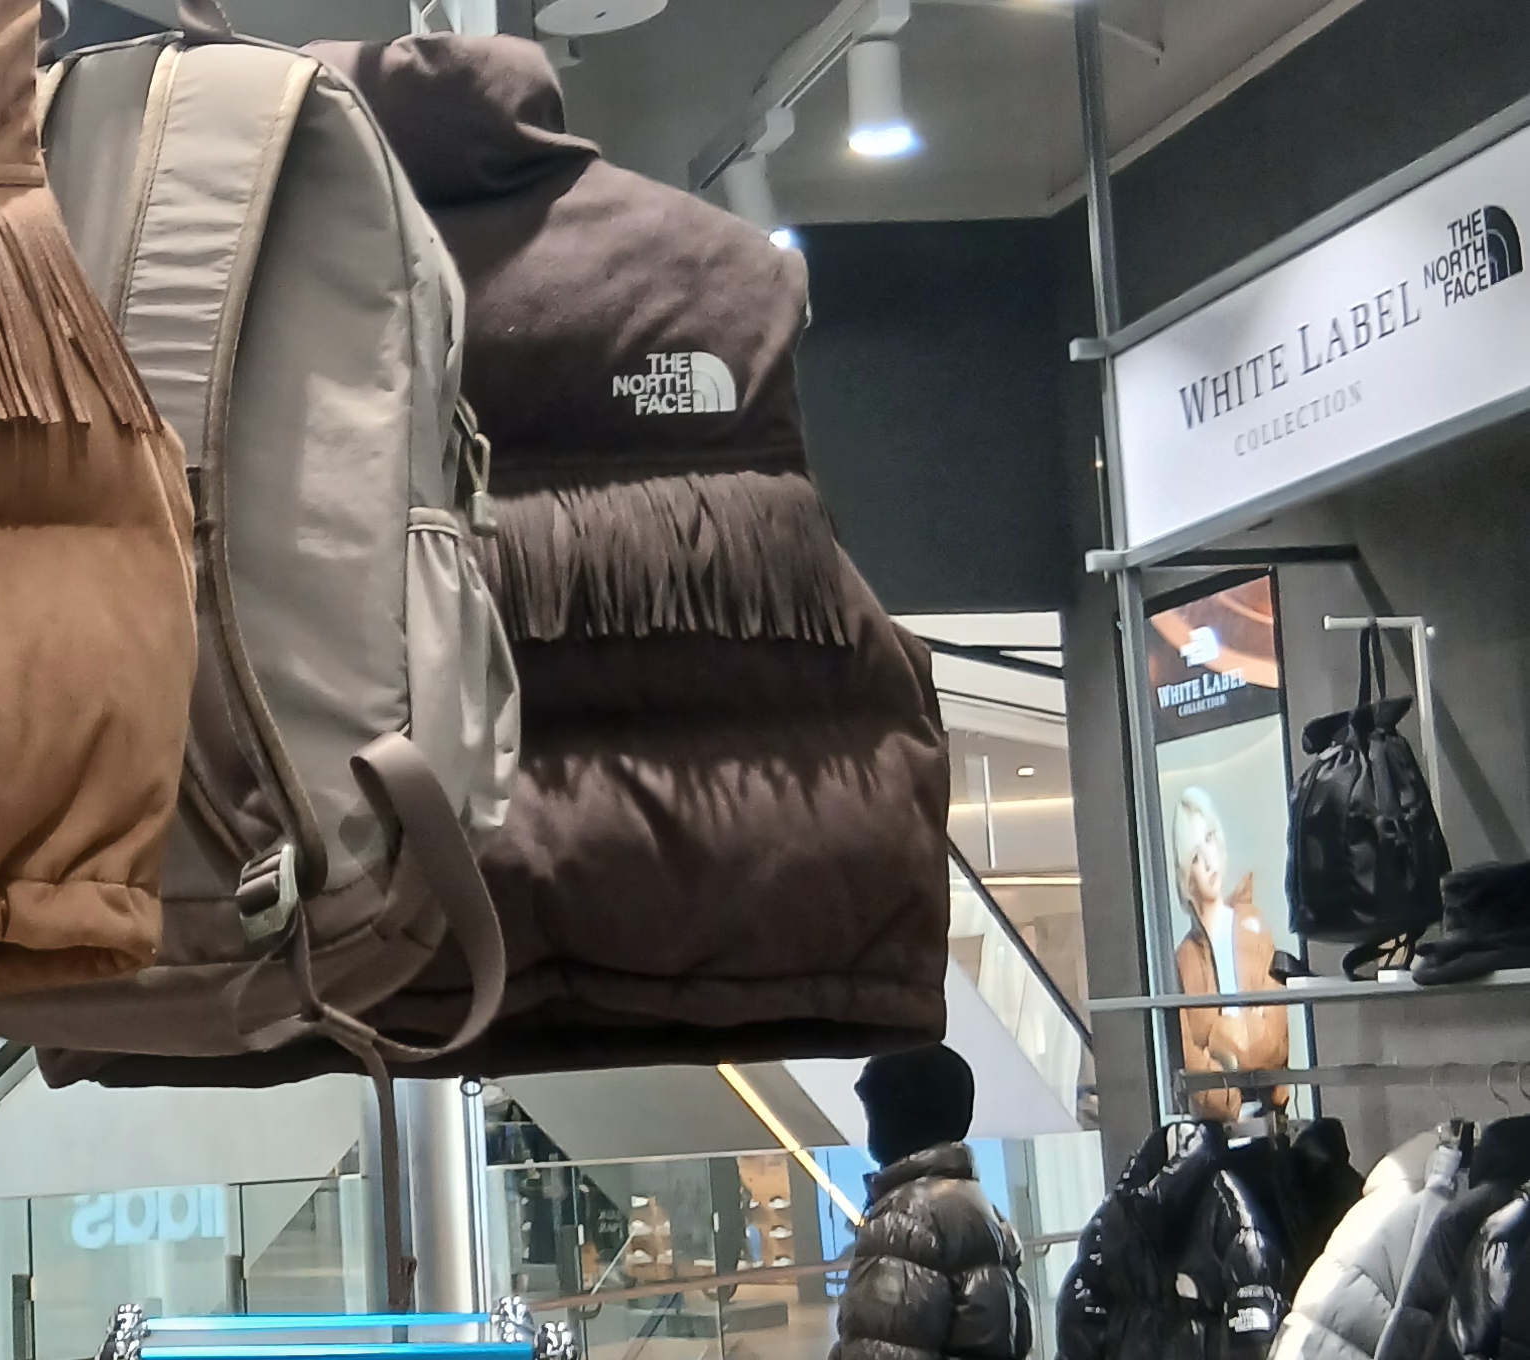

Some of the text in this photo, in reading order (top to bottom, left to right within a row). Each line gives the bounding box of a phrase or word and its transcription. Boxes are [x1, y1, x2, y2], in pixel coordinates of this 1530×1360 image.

[1447, 208, 1484, 249] THE
[1423, 238, 1487, 289] NORTH
[1443, 264, 1490, 308] FACE
[645, 352, 691, 375] THE
[1178, 280, 1421, 431] WHITE LABEL
[612, 372, 692, 398] NORTH
[635, 392, 693, 416] FACE
[1234, 380, 1364, 456] COLLECTION
